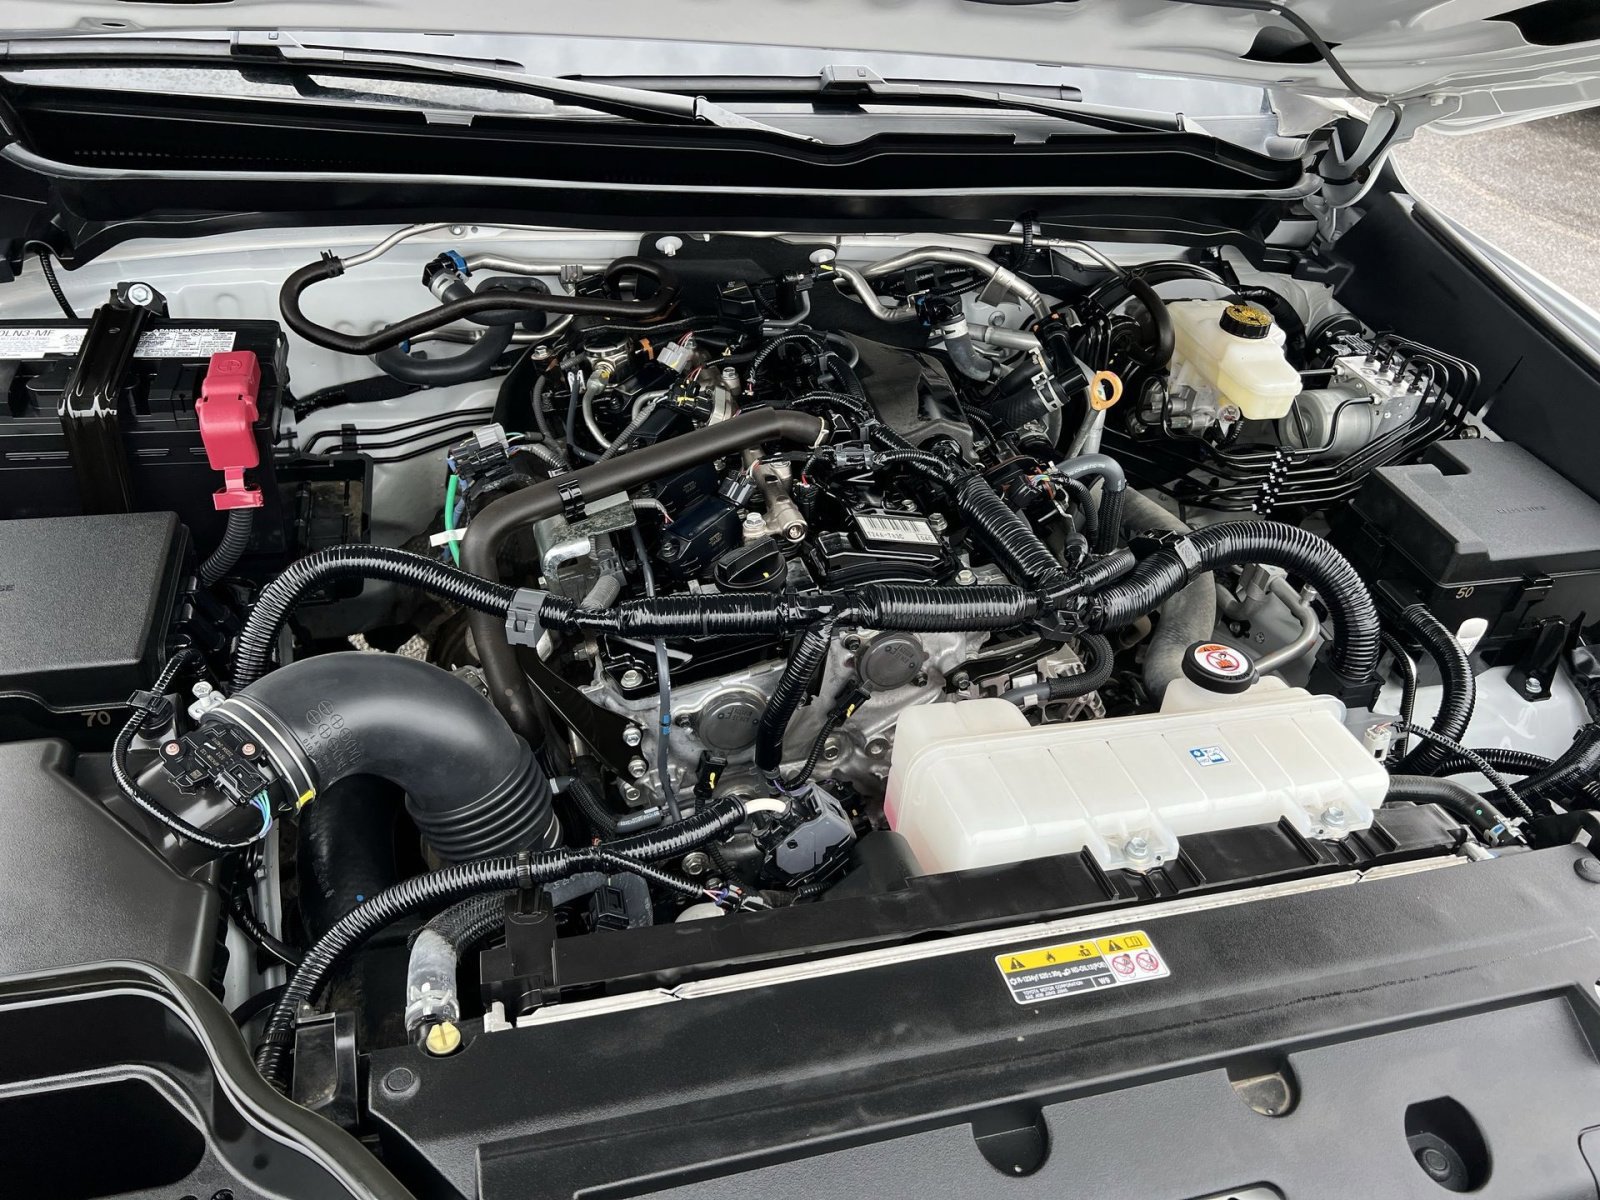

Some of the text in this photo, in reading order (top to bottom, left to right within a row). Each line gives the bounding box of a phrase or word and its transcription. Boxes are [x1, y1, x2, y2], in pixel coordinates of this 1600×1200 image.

[1455, 586, 1475, 599] 50
[80, 710, 111, 728] 70
[1054, 980, 1084, 990] CORPORATION
